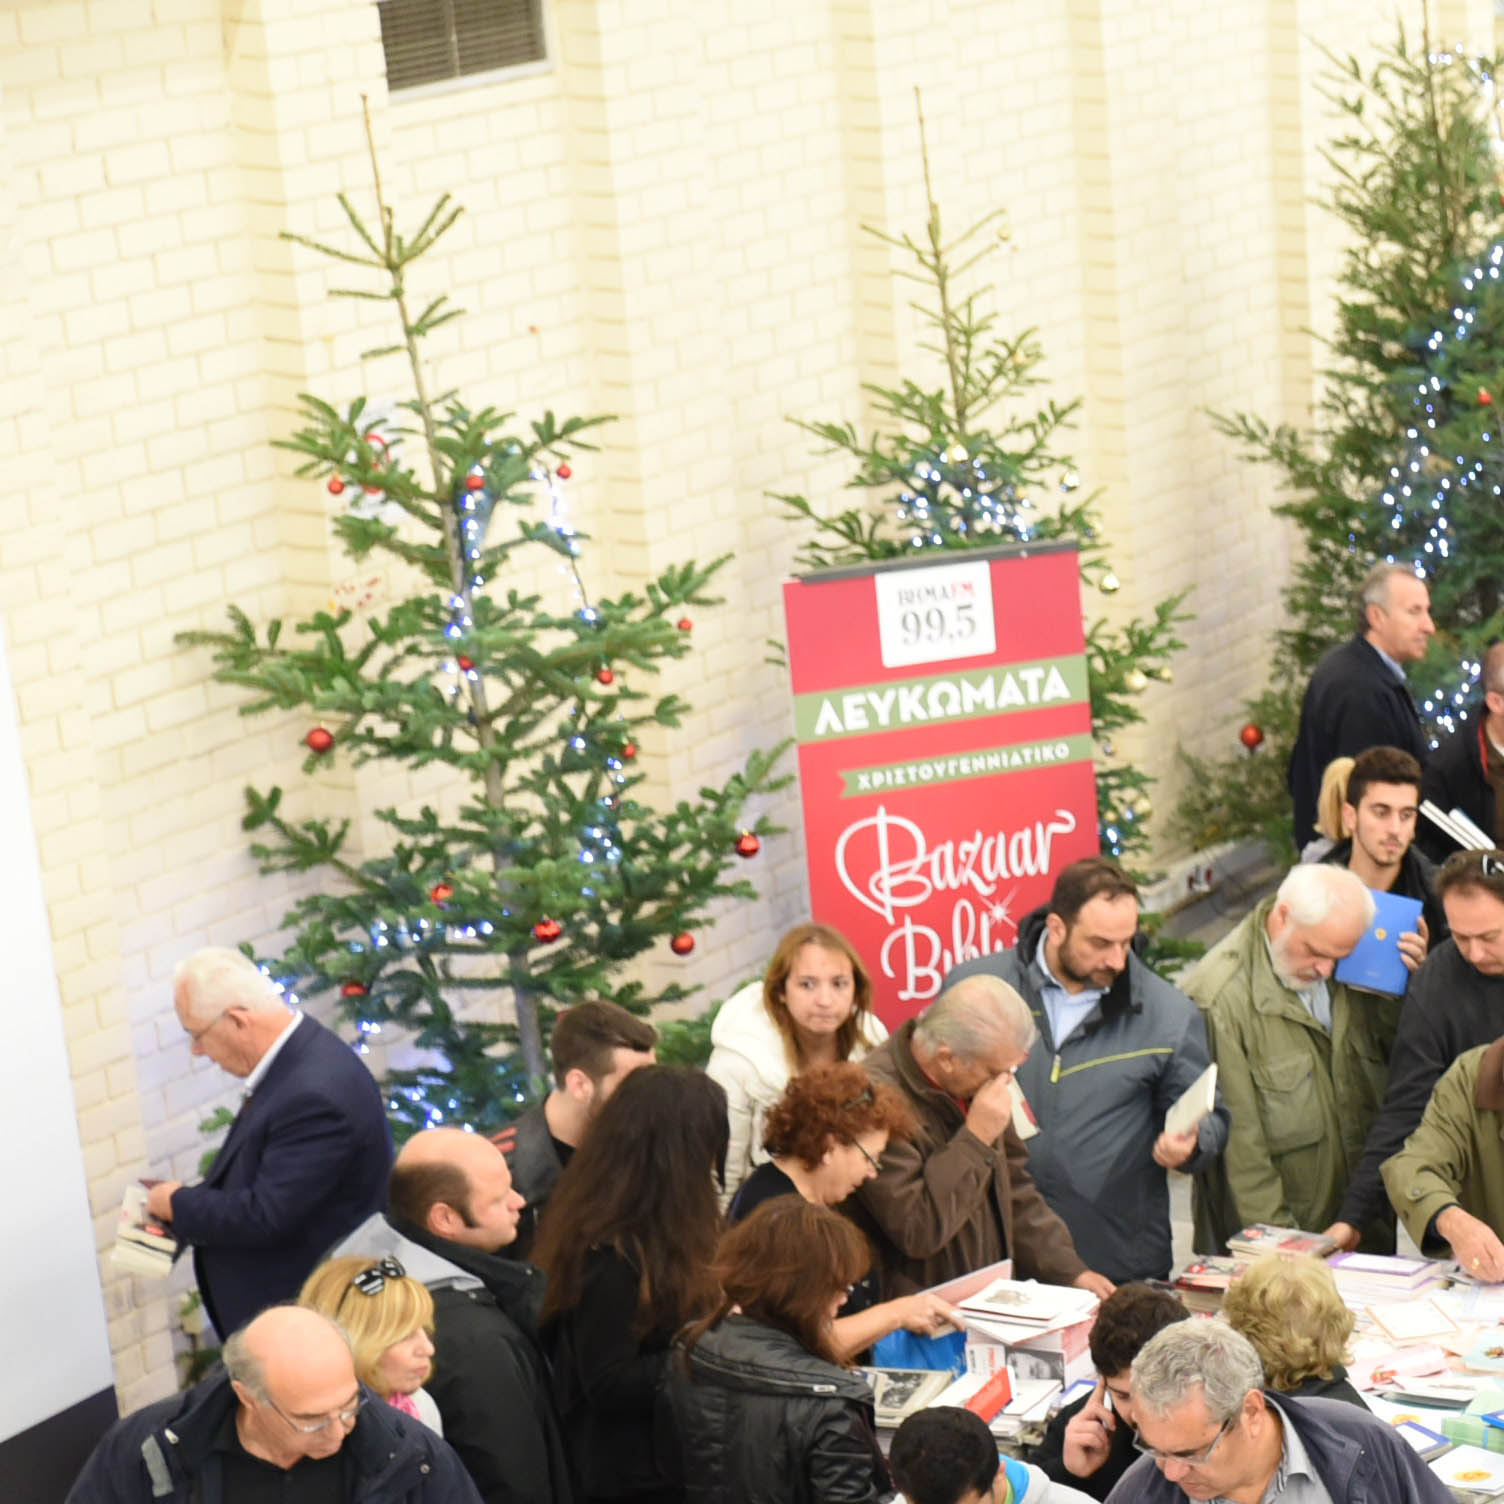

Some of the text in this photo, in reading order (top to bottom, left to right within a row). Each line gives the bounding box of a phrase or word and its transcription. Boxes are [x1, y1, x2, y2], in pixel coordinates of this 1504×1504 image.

[813, 665, 1072, 736] ΛΕΥΚΩΜΑΤΑ
[856, 743, 1071, 791] ΧΡΙΣΤΟΥΓΕΝΝΙΑΤΙΚΟ
[834, 804, 1077, 925] Bazaar
